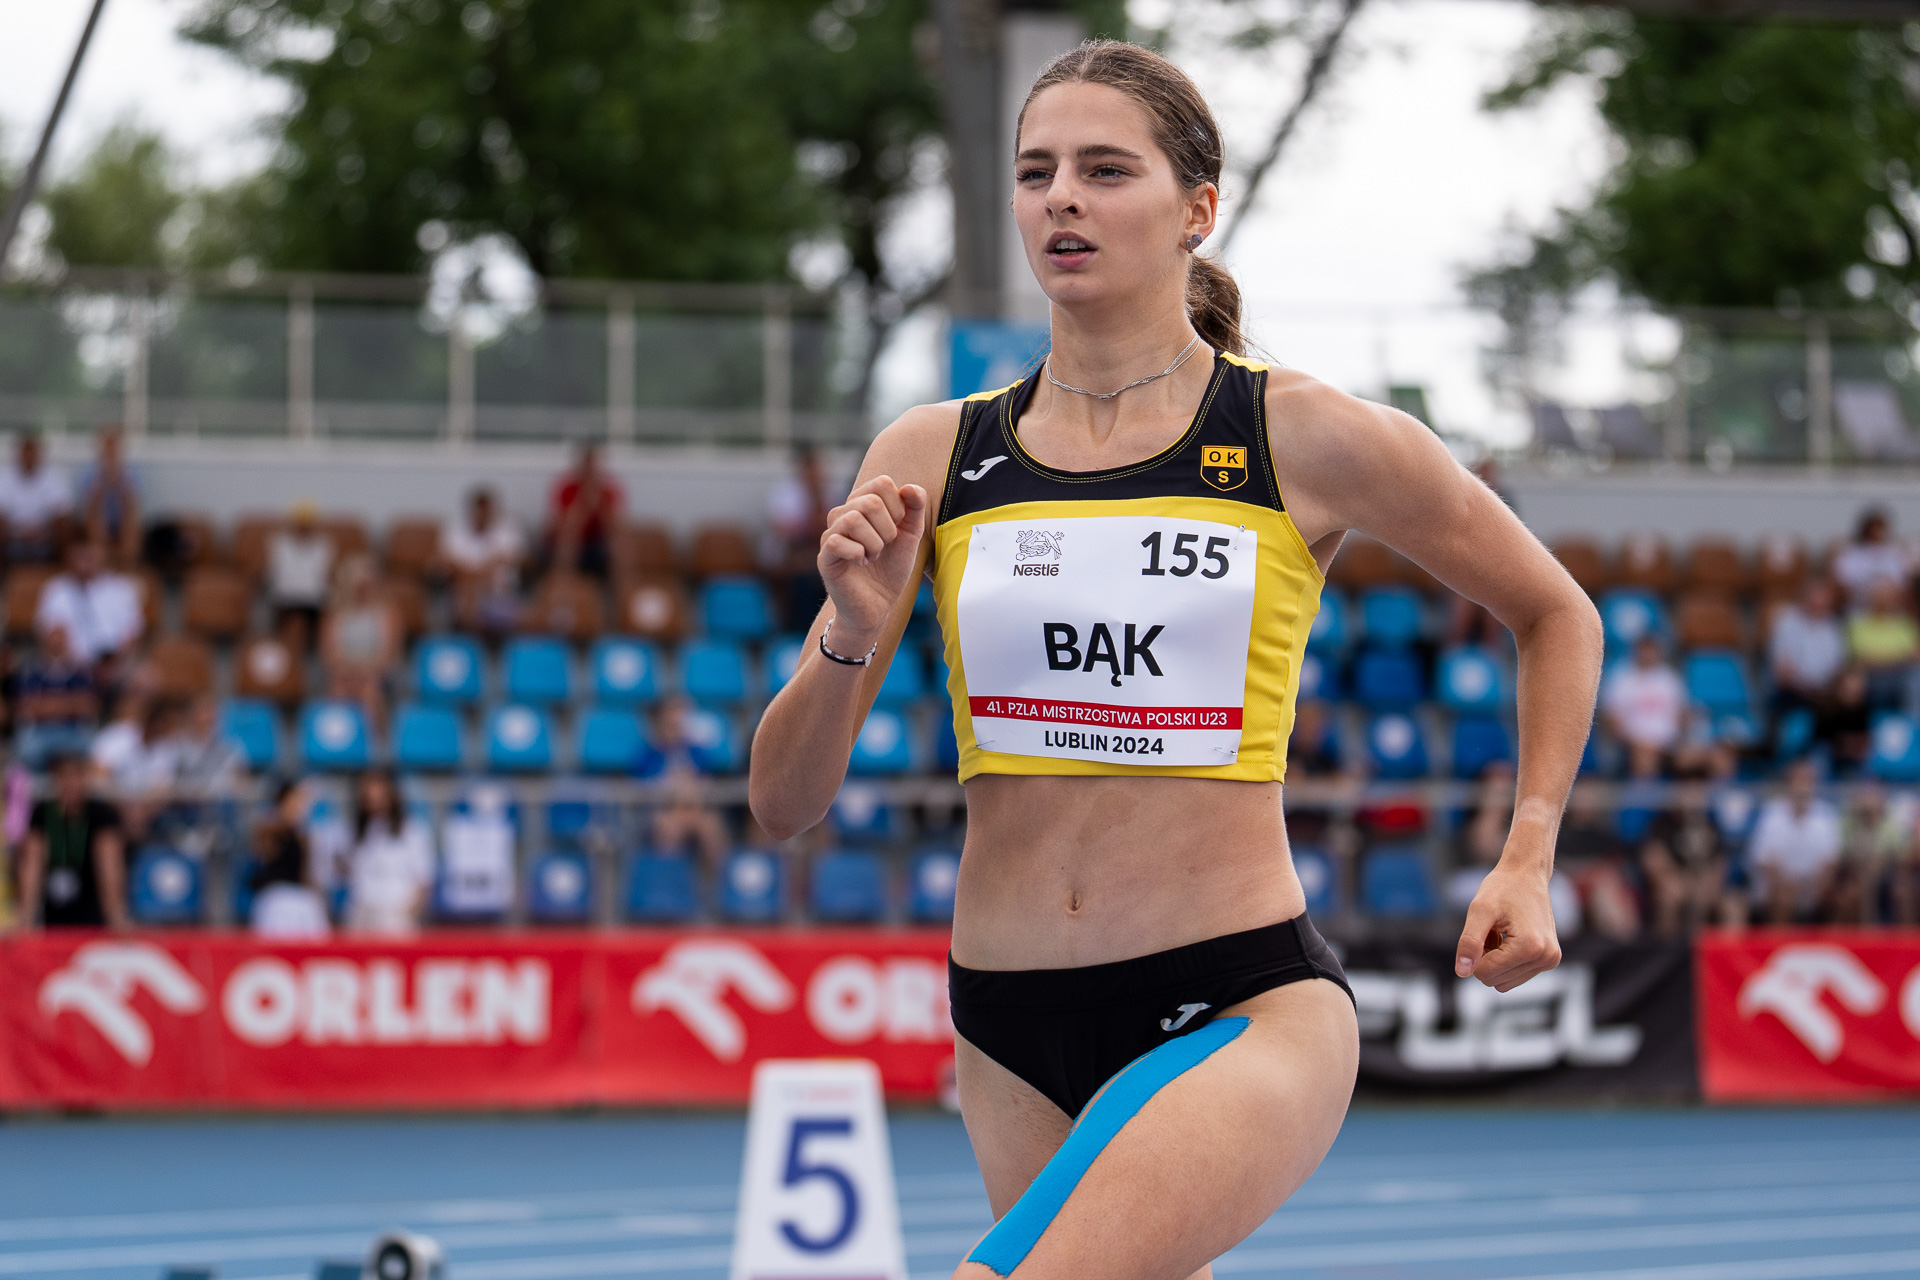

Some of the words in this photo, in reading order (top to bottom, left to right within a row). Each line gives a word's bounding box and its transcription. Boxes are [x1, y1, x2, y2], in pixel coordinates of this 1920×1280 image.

[1012, 563, 1060, 577] Nestlé
[1140, 531, 1231, 580] 155
[1042, 622, 1166, 688] BĄK
[986, 700, 1005, 715] 41.
[1007, 702, 1039, 717] PZLA
[1042, 705, 1142, 726] MISTRZOSTWA
[1146, 712, 1196, 726] POLSKI
[1199, 712, 1228, 726] U23
[1044, 730, 1108, 752] LUBLIN
[1112, 735, 1165, 755] 2024
[222, 955, 551, 1046] ORLEN
[777, 1116, 860, 1256] 5
